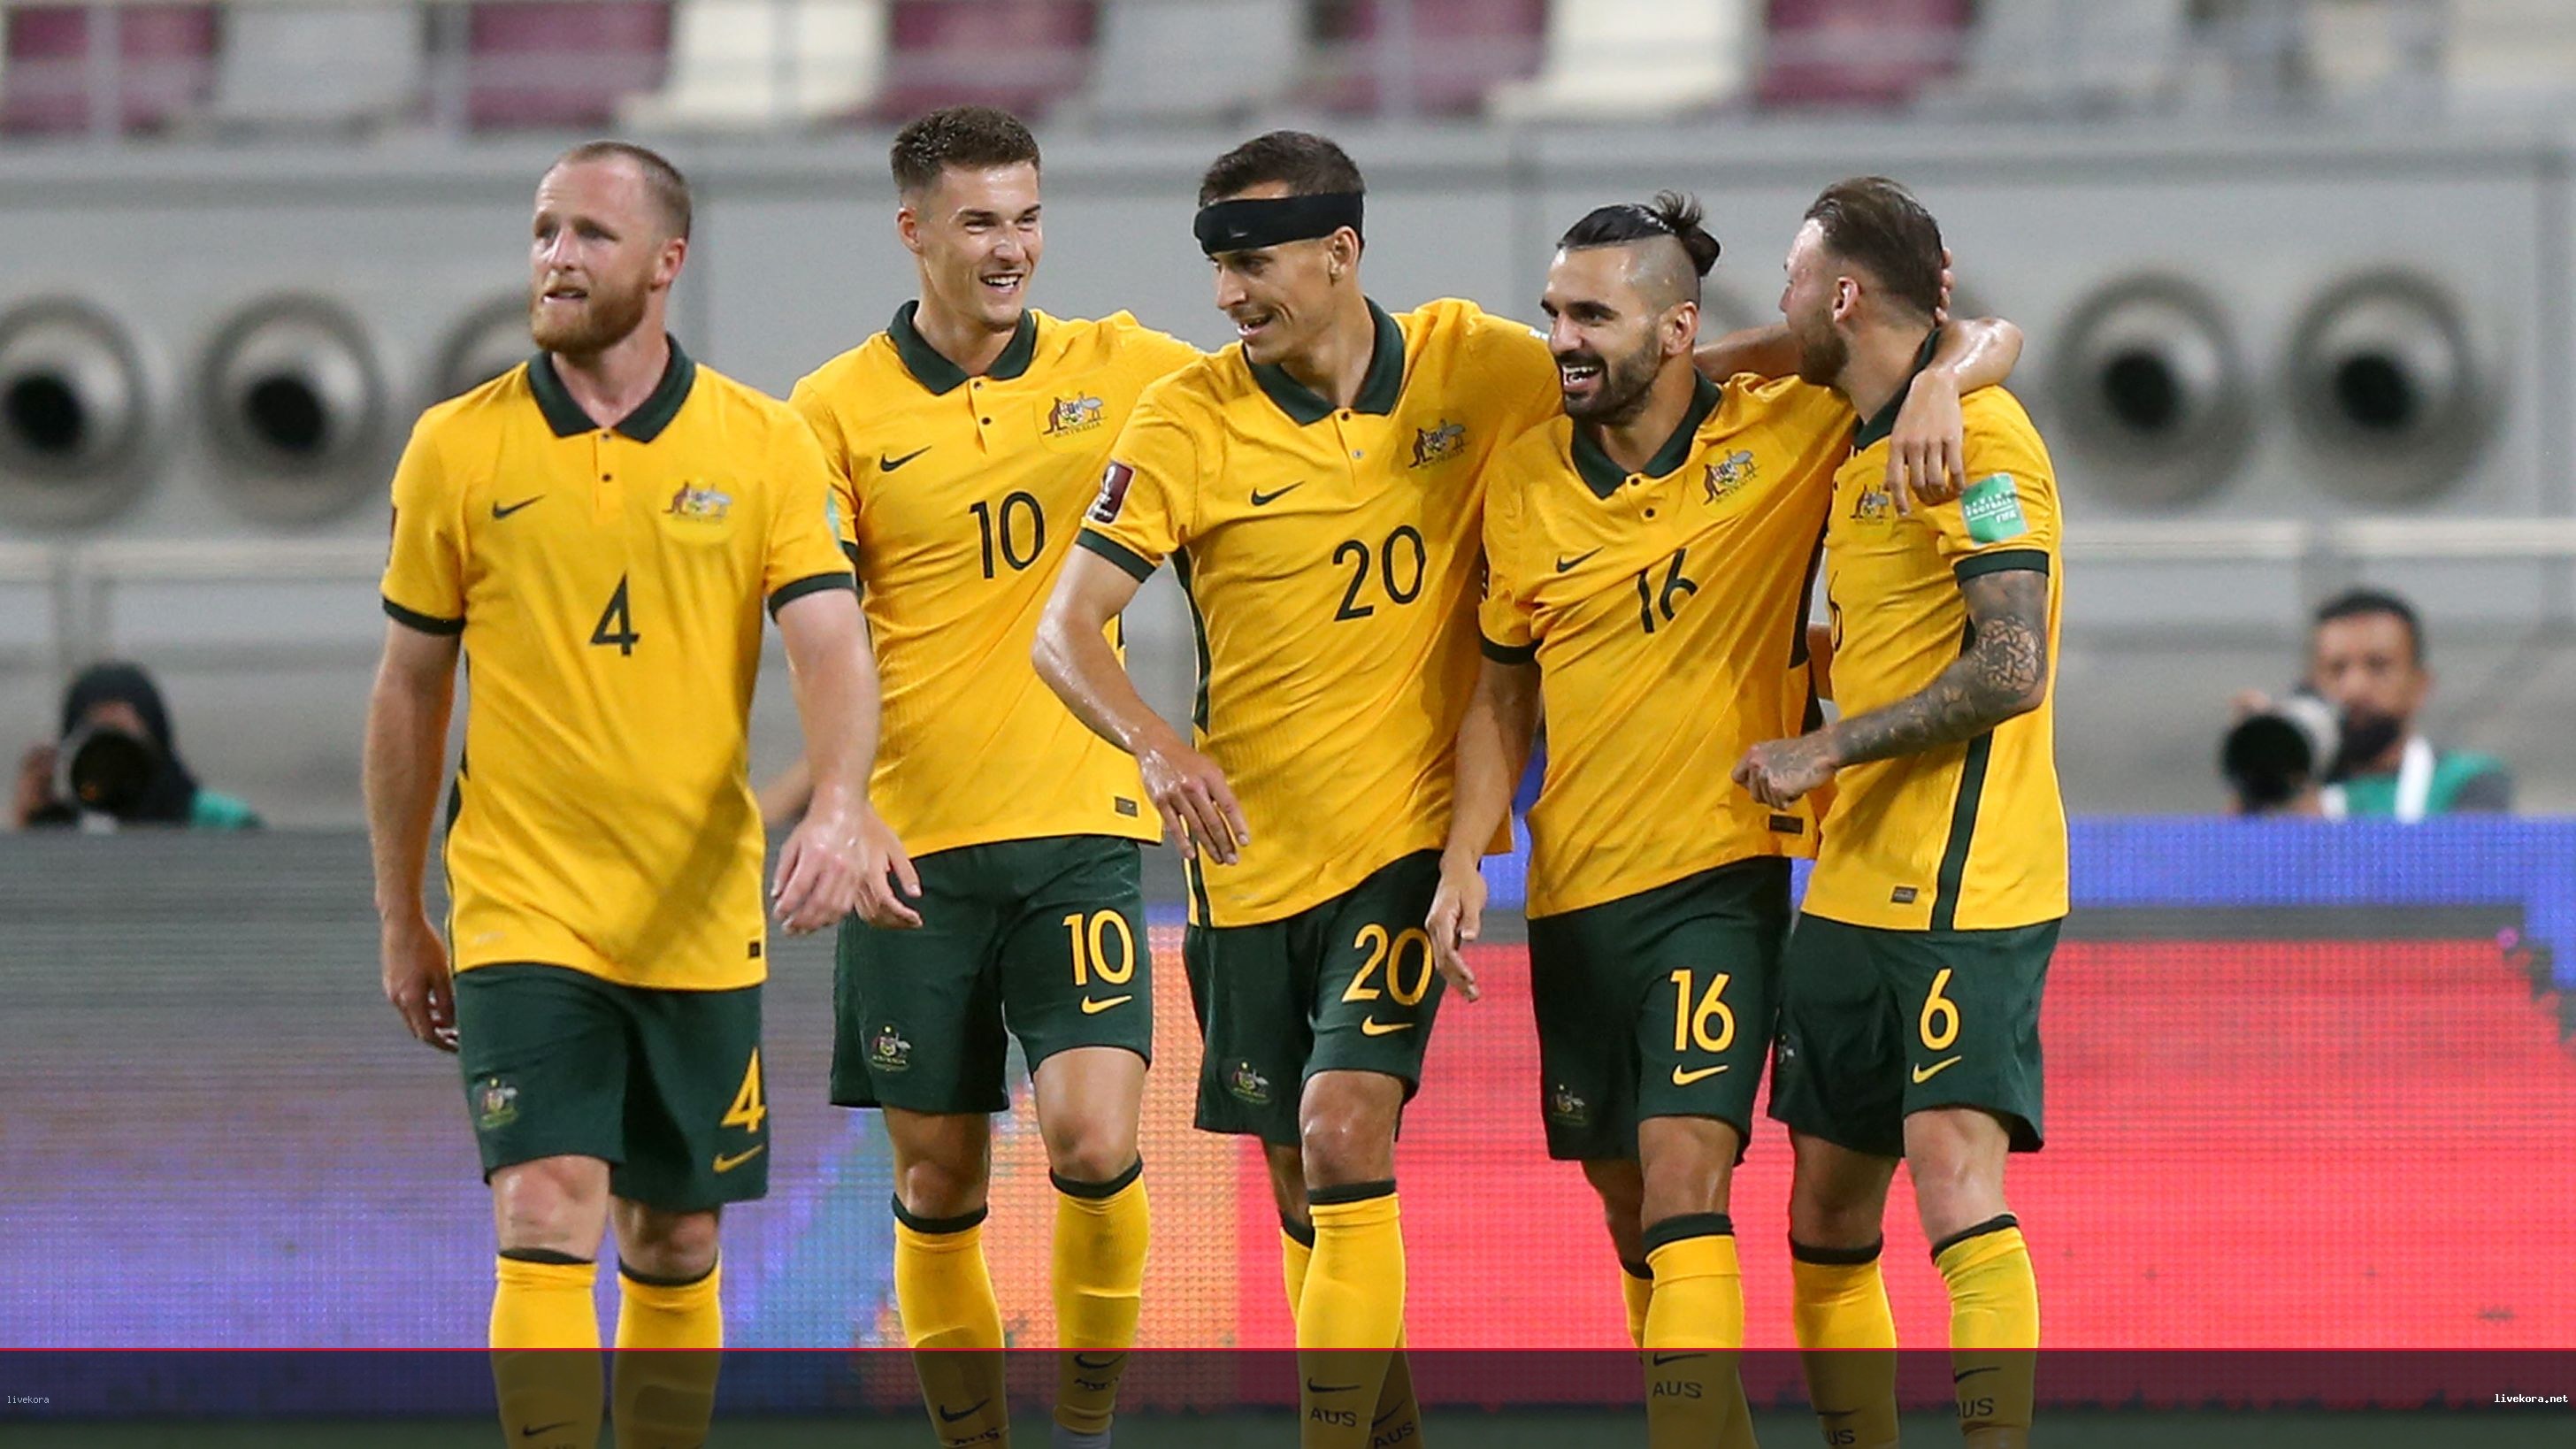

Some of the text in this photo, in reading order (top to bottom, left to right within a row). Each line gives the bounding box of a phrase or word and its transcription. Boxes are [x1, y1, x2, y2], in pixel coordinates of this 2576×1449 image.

[970, 491, 1045, 579] 10
[1996, 510, 2017, 524] FIFA
[590, 573, 640, 656] 4
[1333, 525, 1427, 622] 20
[1637, 548, 1698, 634] 16
[1062, 909, 1135, 986] 10
[1341, 924, 1433, 1007] 20
[1670, 969, 1735, 1052] 16
[1920, 968, 1960, 1051] 6
[722, 1047, 767, 1133] 4
[1310, 1407, 1357, 1428] AUS
[1653, 1381, 1702, 1399] AUS
[1373, 1420, 1415, 1449] AUS
[1823, 1429, 1856, 1446] US
